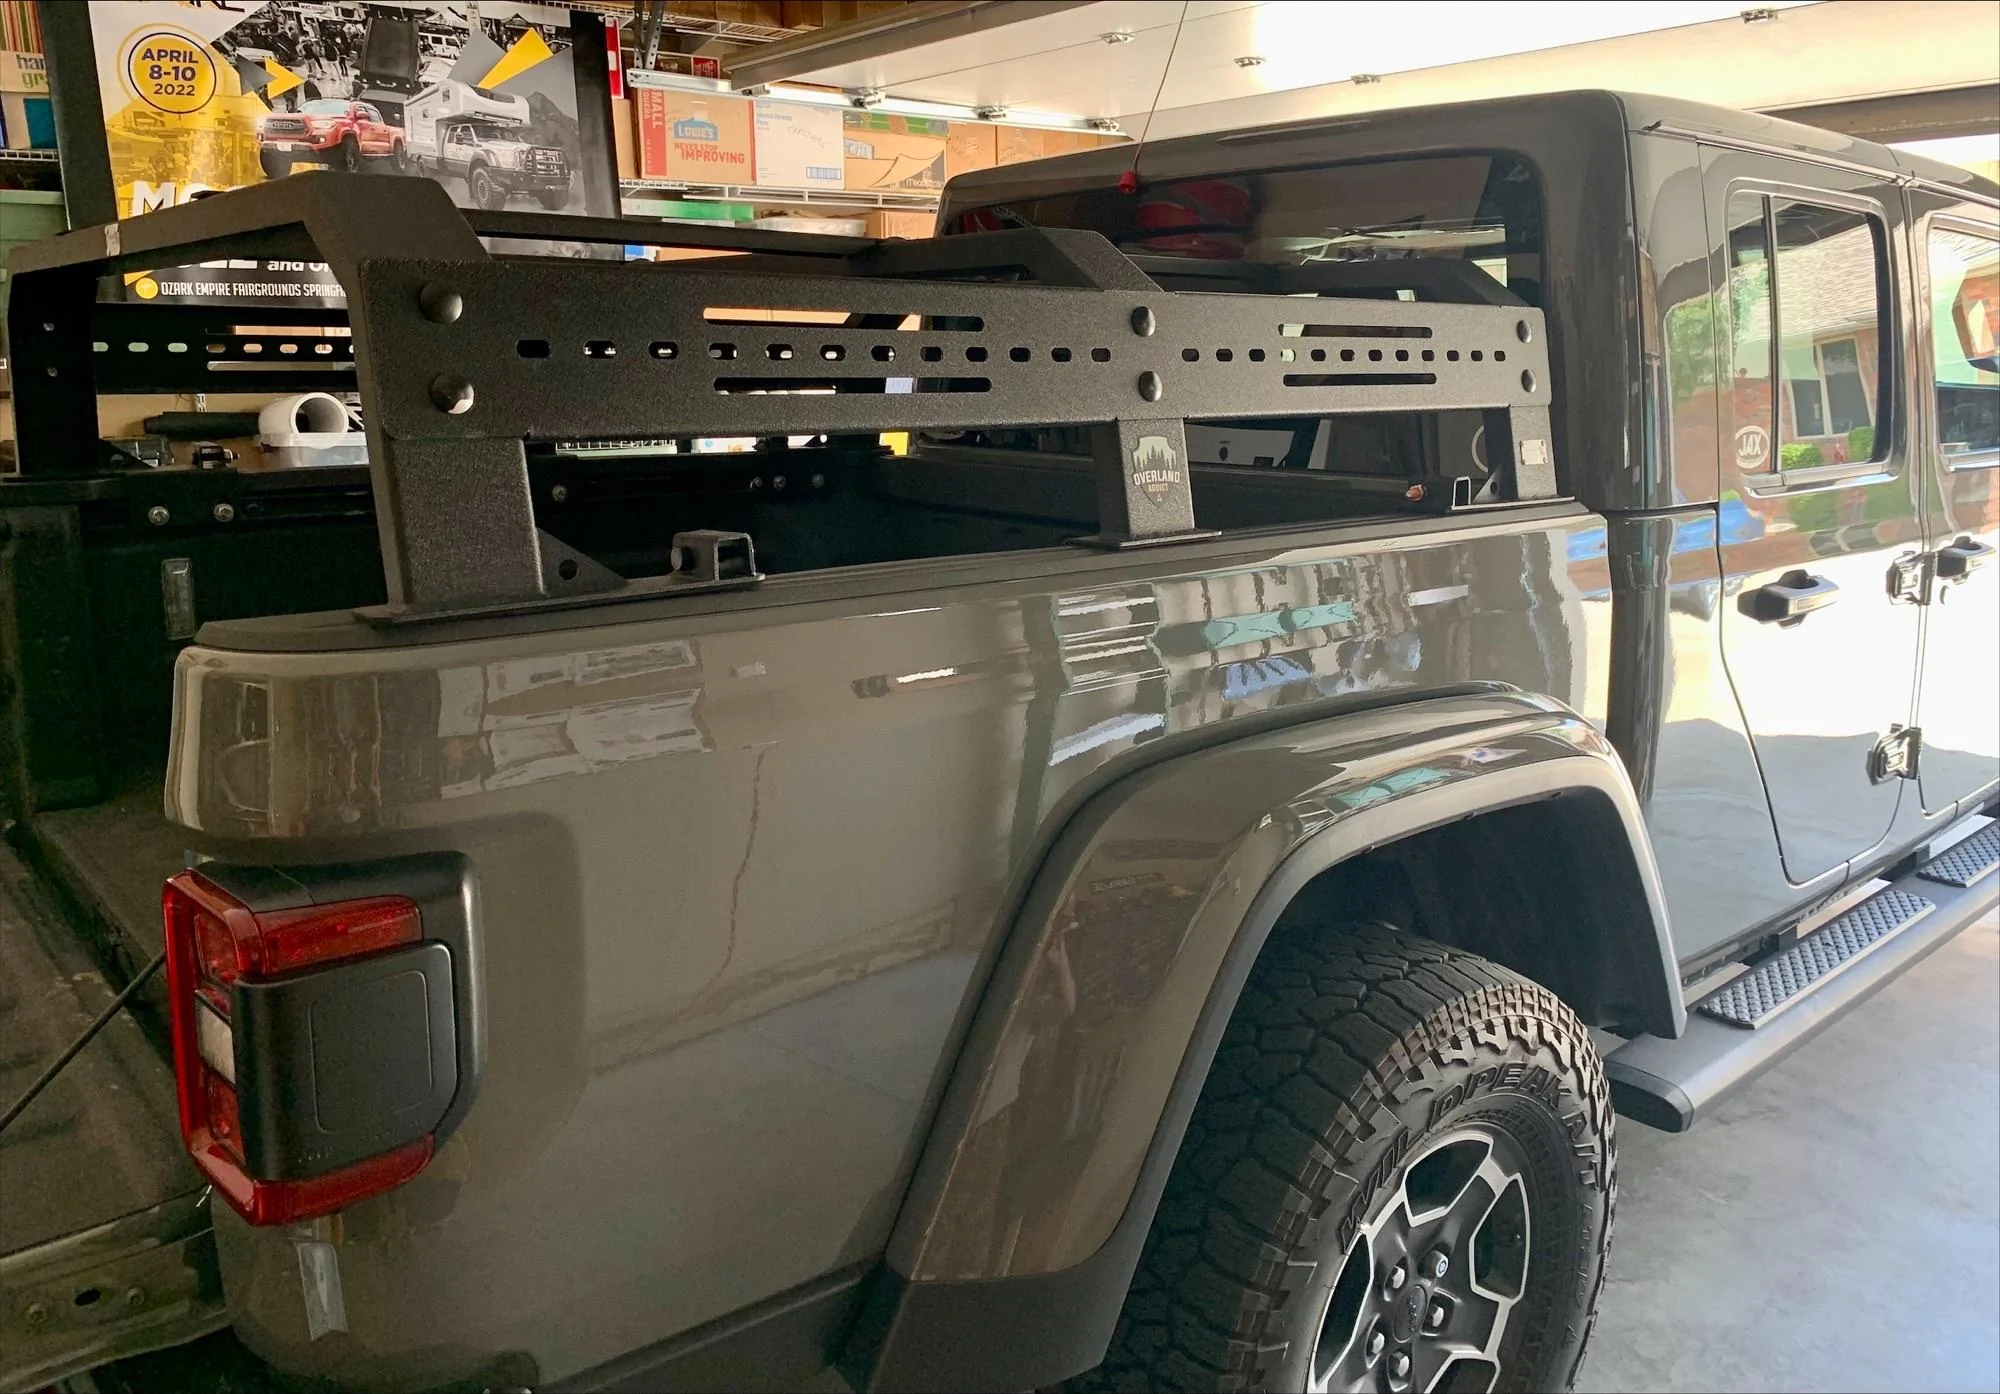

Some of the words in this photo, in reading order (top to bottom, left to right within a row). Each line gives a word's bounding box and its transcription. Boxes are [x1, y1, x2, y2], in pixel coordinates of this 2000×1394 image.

[141, 48, 199, 64] APRIL
[149, 65, 196, 82] 8-10
[153, 83, 196, 96] 2022
[651, 91, 664, 129] MALL
[678, 124, 714, 139] LOWE'S
[674, 143, 698, 151] NEVER
[700, 144, 718, 152] STOP
[680, 149, 746, 164] IMPROVING
[161, 282, 194, 296] OZARK
[195, 282, 231, 296] EMPIRE
[233, 283, 301, 297] FAIRGROUNDS
[1738, 434, 1761, 456] JAX
[1133, 469, 1180, 486] OVERLAND
[1147, 483, 1169, 492] ADDICT
